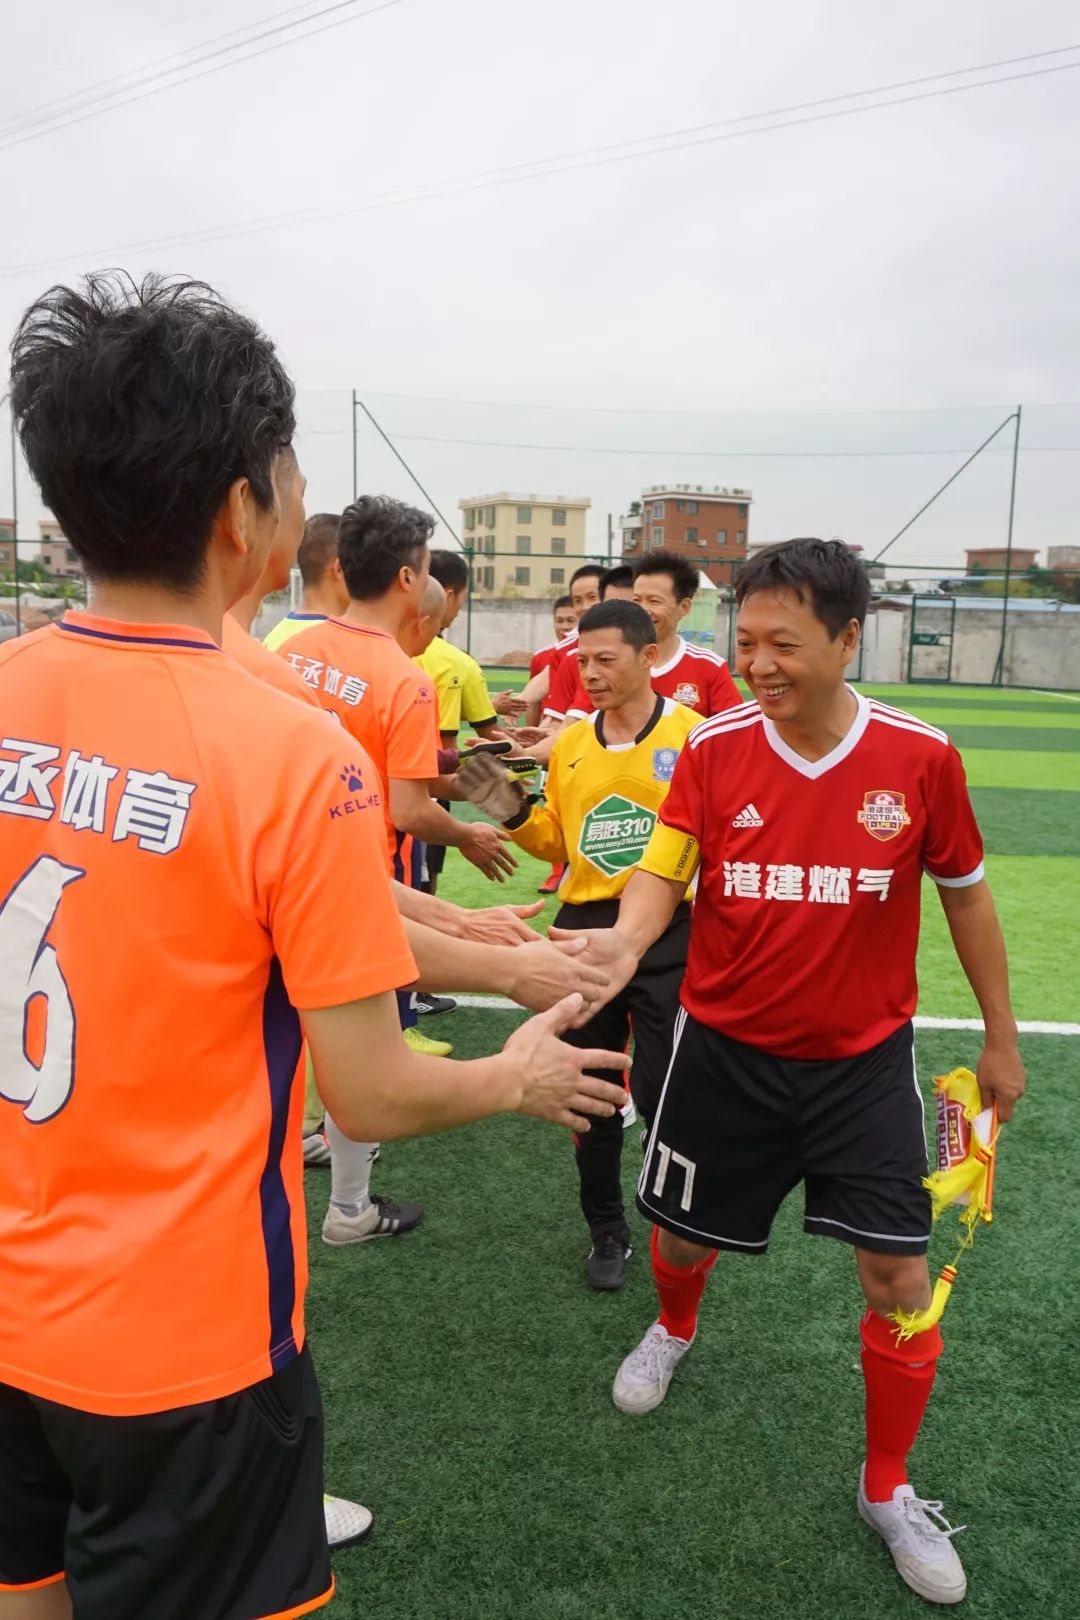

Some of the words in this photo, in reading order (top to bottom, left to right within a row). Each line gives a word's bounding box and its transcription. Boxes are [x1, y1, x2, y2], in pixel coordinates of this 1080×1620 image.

[0, 737, 198, 855] 丞体育
[329, 794, 381, 819] KELME
[860, 813, 907, 822] FOOTBALL
[732, 818, 764, 828] adidas
[722, 861, 895, 905] 港建燃气
[0, 854, 87, 1124] 6
[936, 1093, 948, 1171] OOTBALL
[948, 1119, 959, 1145] LPG
[652, 1140, 697, 1212] 17
